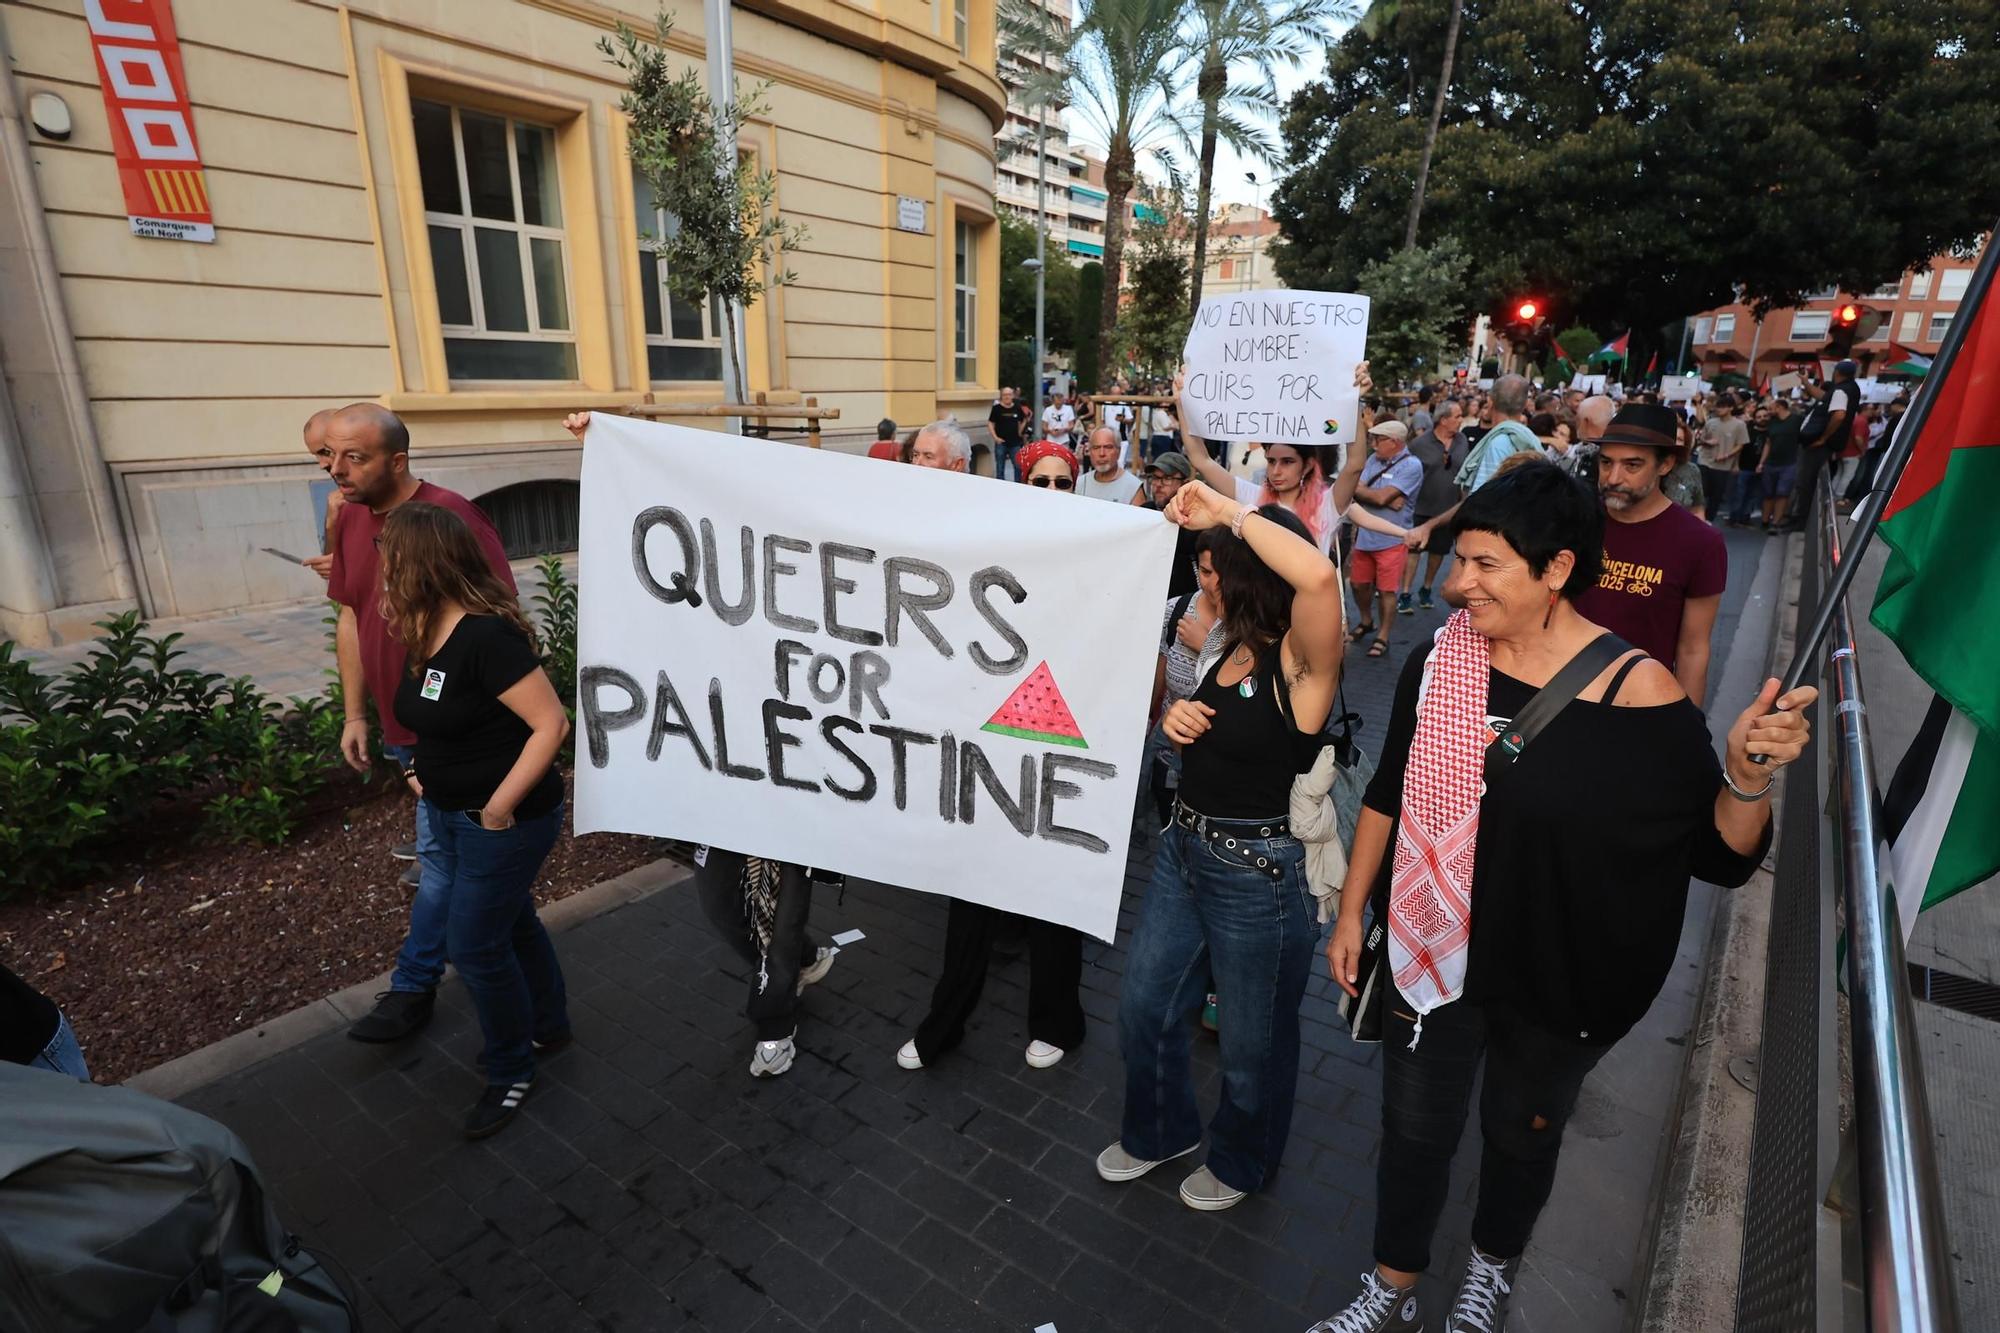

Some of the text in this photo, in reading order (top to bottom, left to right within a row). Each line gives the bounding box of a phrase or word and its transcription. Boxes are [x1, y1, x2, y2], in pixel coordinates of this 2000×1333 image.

[135, 217, 197, 231] Comarques
[158, 229, 184, 238] Nord
[1195, 301, 1365, 331] NO EN NUESTRO
[1277, 373, 1323, 402] POR
[632, 505, 1027, 676] QUEERS
[1595, 573, 1626, 591] 025
[775, 638, 891, 721] FOR
[580, 665, 1118, 854] PALESTINE
